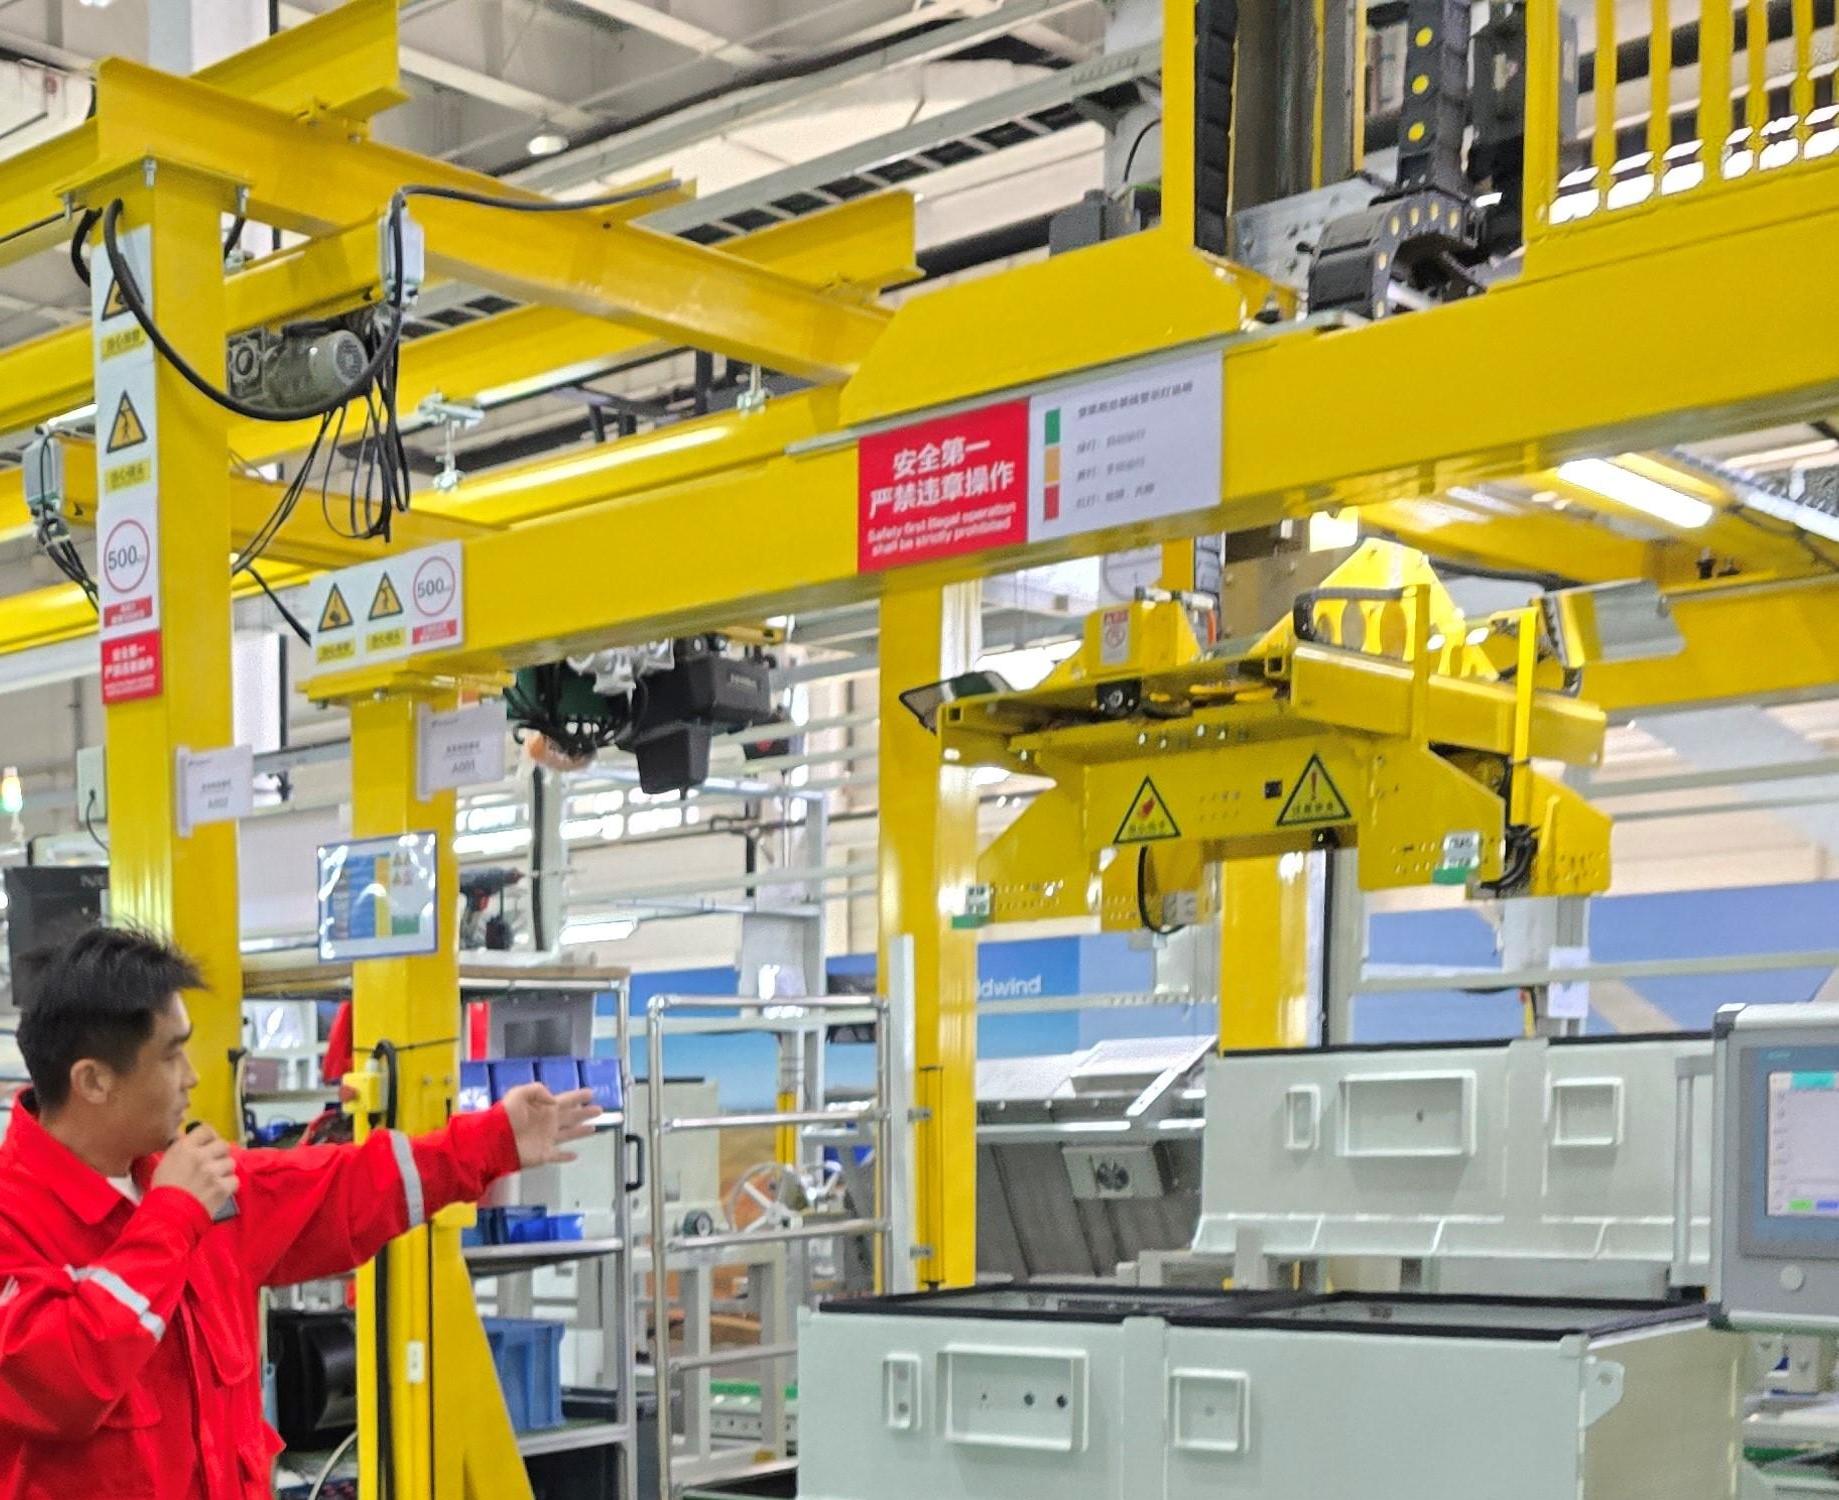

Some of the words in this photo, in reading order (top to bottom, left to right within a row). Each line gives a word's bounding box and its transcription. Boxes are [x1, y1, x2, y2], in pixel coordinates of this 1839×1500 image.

[893, 436, 991, 480] 安全第一
[869, 460, 1016, 520] 严禁违章操作
[867, 526, 903, 544] Safety
[962, 501, 1017, 524] operation
[871, 540, 899, 557] shall
[899, 536, 914, 551] be
[915, 529, 953, 548] strictly
[953, 515, 1012, 543] prohibited
